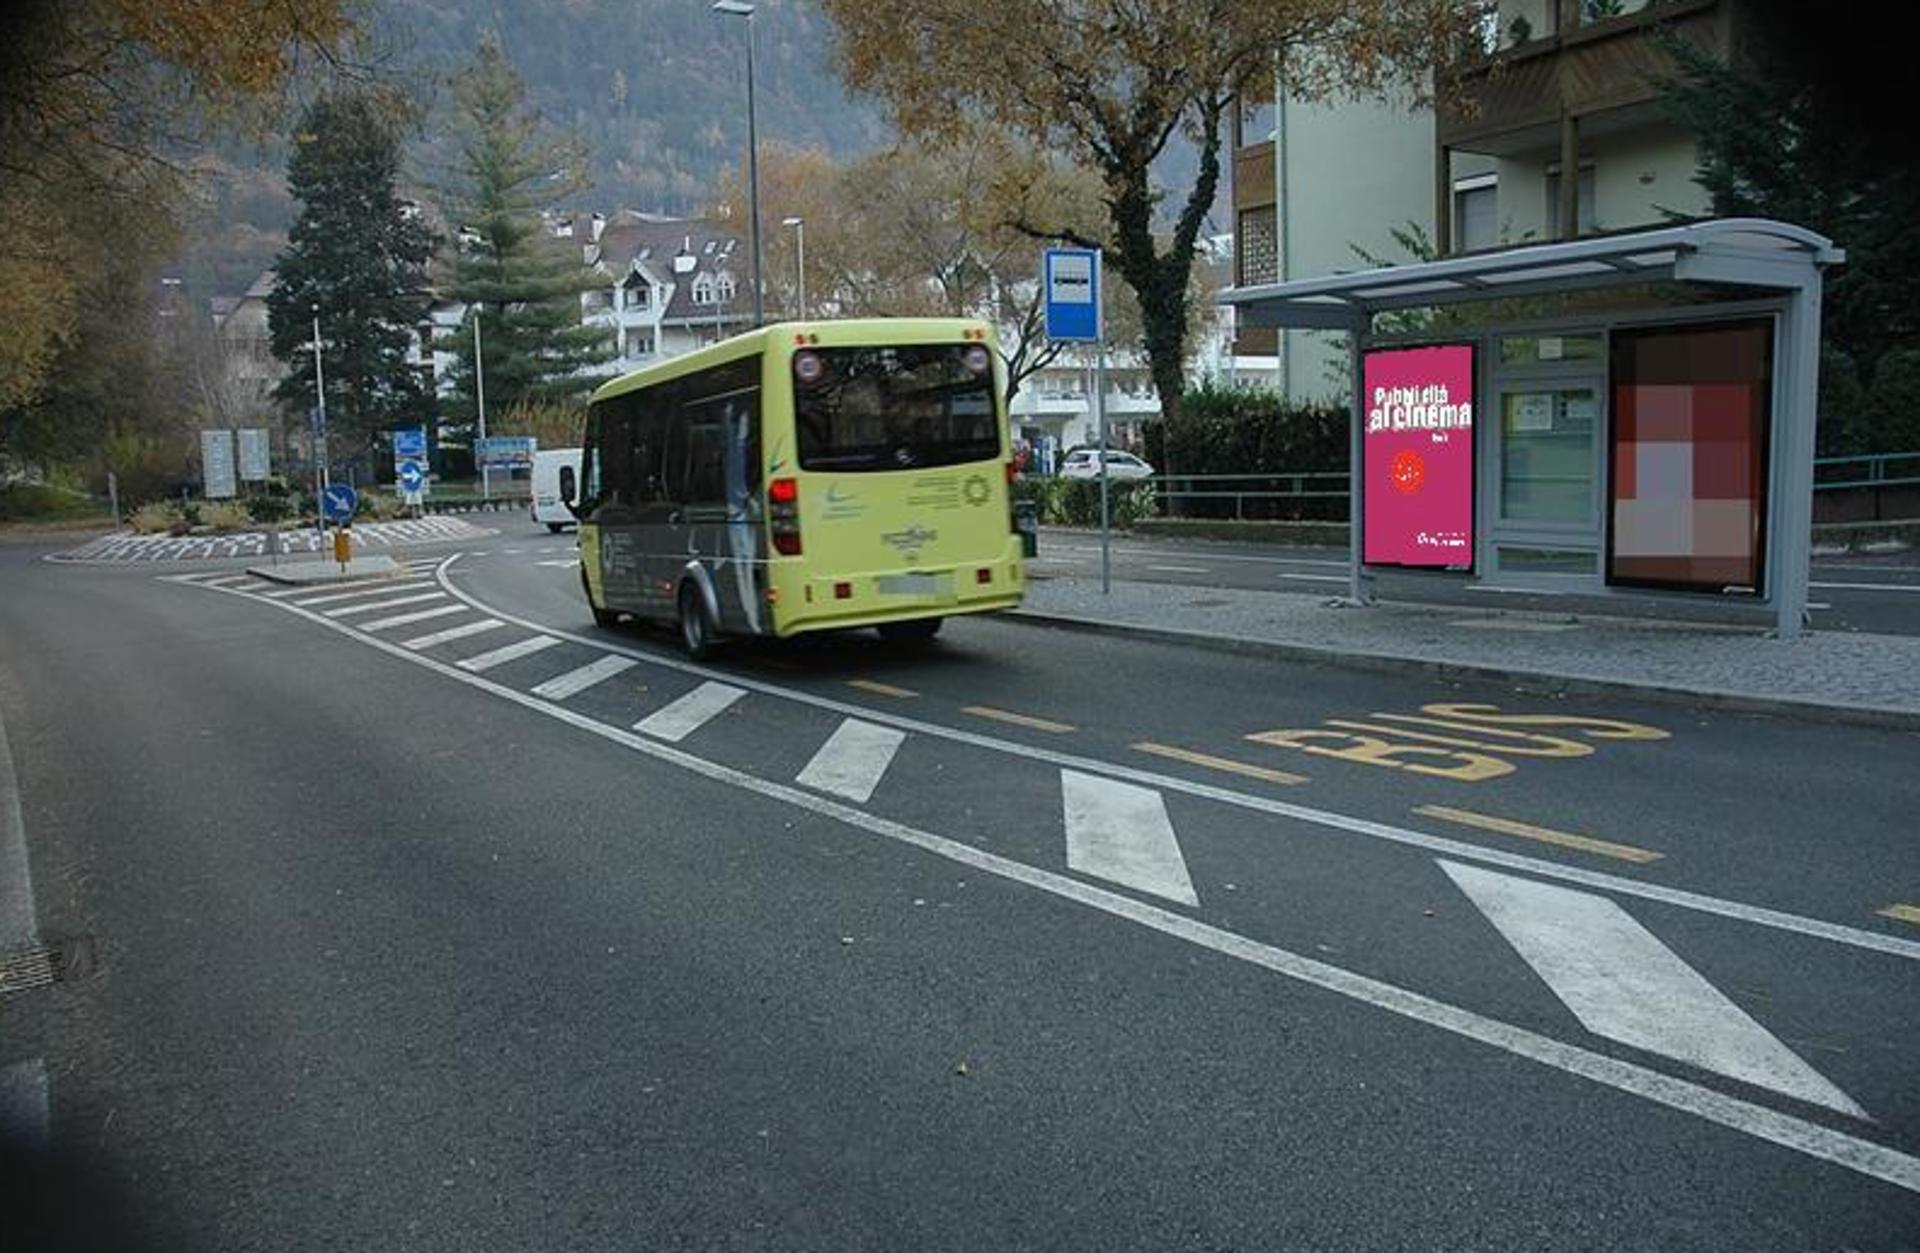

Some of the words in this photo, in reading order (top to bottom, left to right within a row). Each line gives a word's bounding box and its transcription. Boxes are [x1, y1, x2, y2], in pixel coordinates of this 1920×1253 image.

[1370, 402, 1390, 430] al
[1393, 402, 1472, 429] cinema
[1243, 703, 1672, 781] BUS
